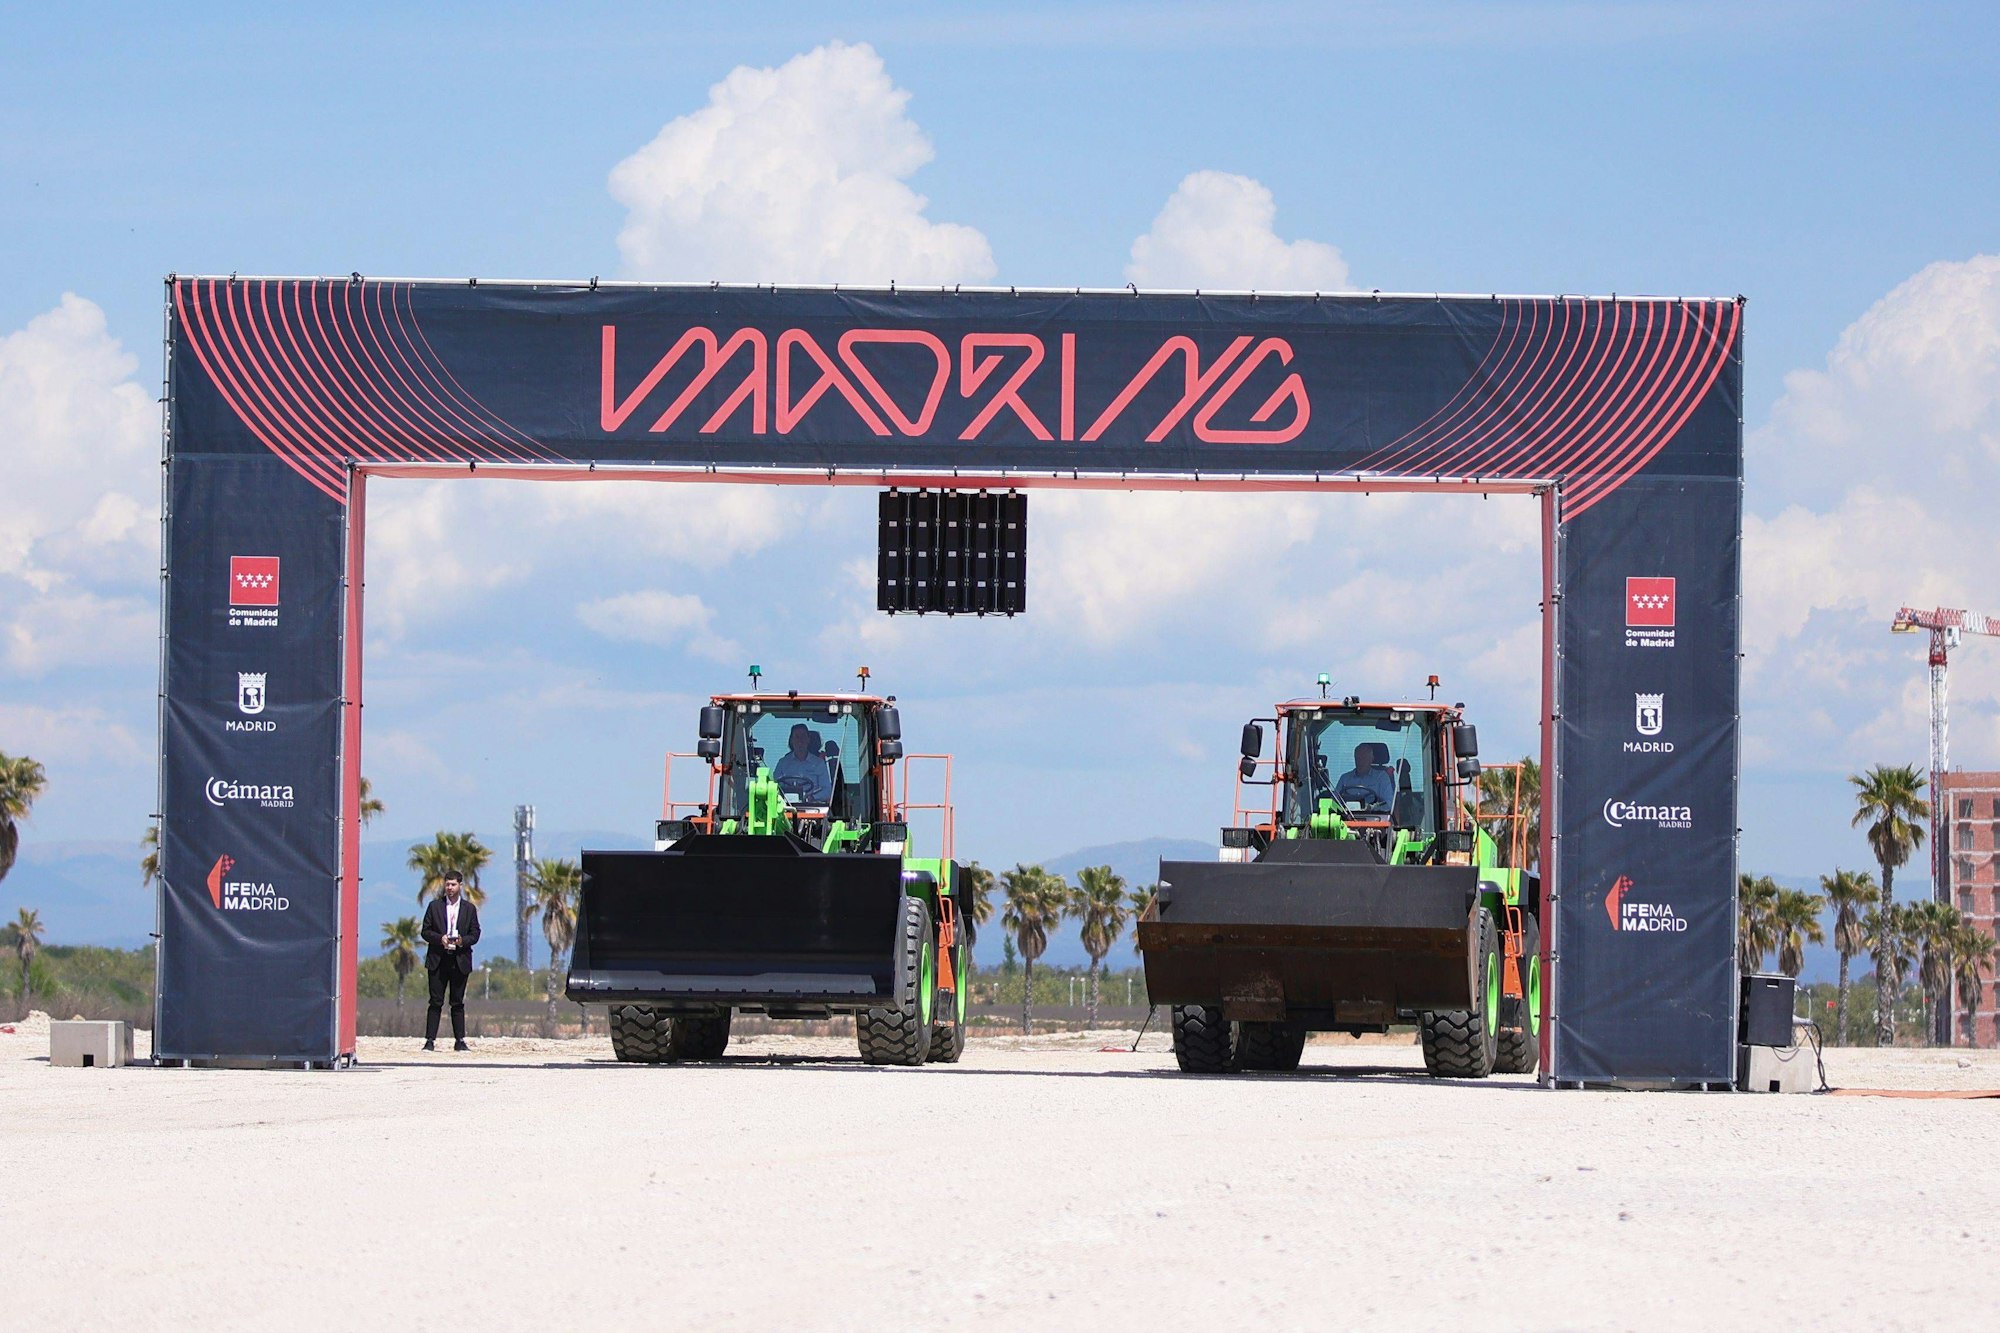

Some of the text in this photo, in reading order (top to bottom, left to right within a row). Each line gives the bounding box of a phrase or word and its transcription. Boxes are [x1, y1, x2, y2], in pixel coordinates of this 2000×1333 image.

[229, 607, 279, 617] Comunidad
[229, 617, 279, 627] de Madrid
[1625, 628, 1675, 638] Comunidad
[1625, 638, 1675, 648] de Madrid
[226, 721, 277, 732] MADRID
[1623, 742, 1675, 753] MADRID
[213, 779, 295, 801] Cámara
[260, 799, 294, 808] MADRID
[1609, 800, 1692, 821] Cámara
[1658, 820, 1692, 829] MADRID
[224, 882, 276, 896] IFEMA
[224, 896, 290, 911] MADRID
[1622, 903, 1674, 917] IFEMA
[1622, 917, 1688, 932] MADRID
